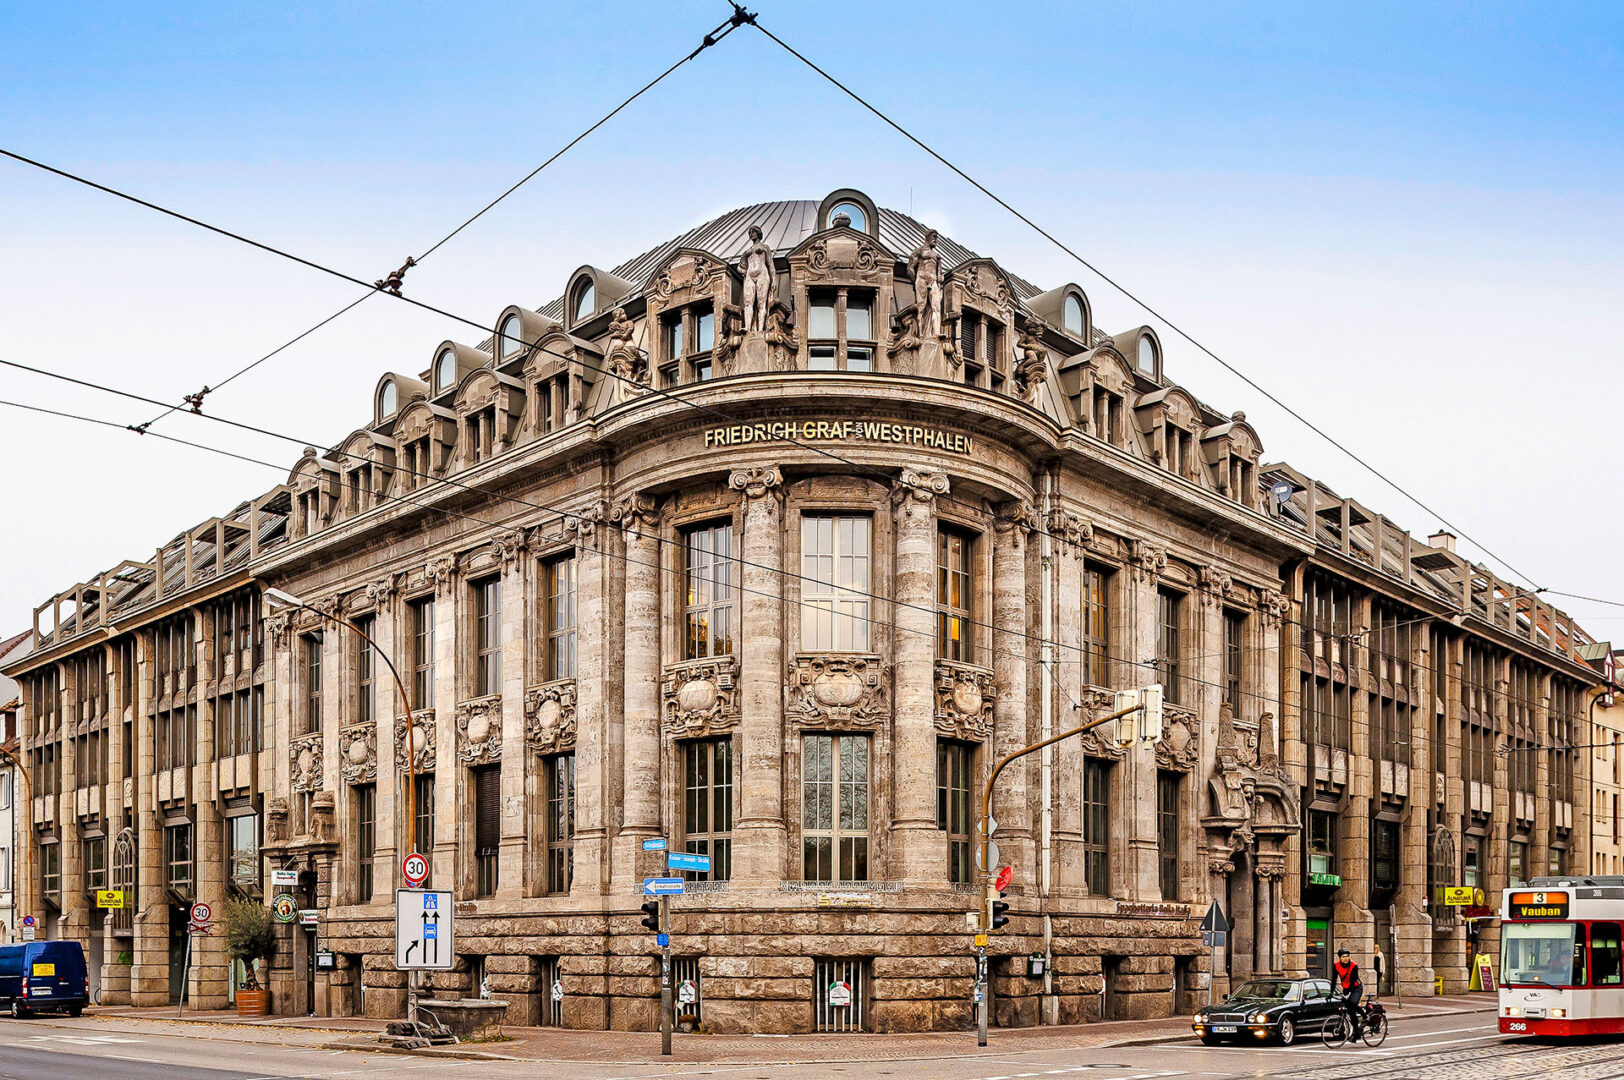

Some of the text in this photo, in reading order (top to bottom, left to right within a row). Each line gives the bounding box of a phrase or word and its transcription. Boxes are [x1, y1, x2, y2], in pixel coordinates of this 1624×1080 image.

[704, 422, 797, 447] FRIEDRICH
[802, 421, 853, 439] GRAF
[864, 422, 973, 454] WESTPHALEN
[408, 862, 424, 875] 30
[1536, 893, 1544, 903] 3
[195, 908, 208, 917] 30
[1521, 907, 1560, 916] Vauban
[1509, 1023, 1526, 1031] 266
